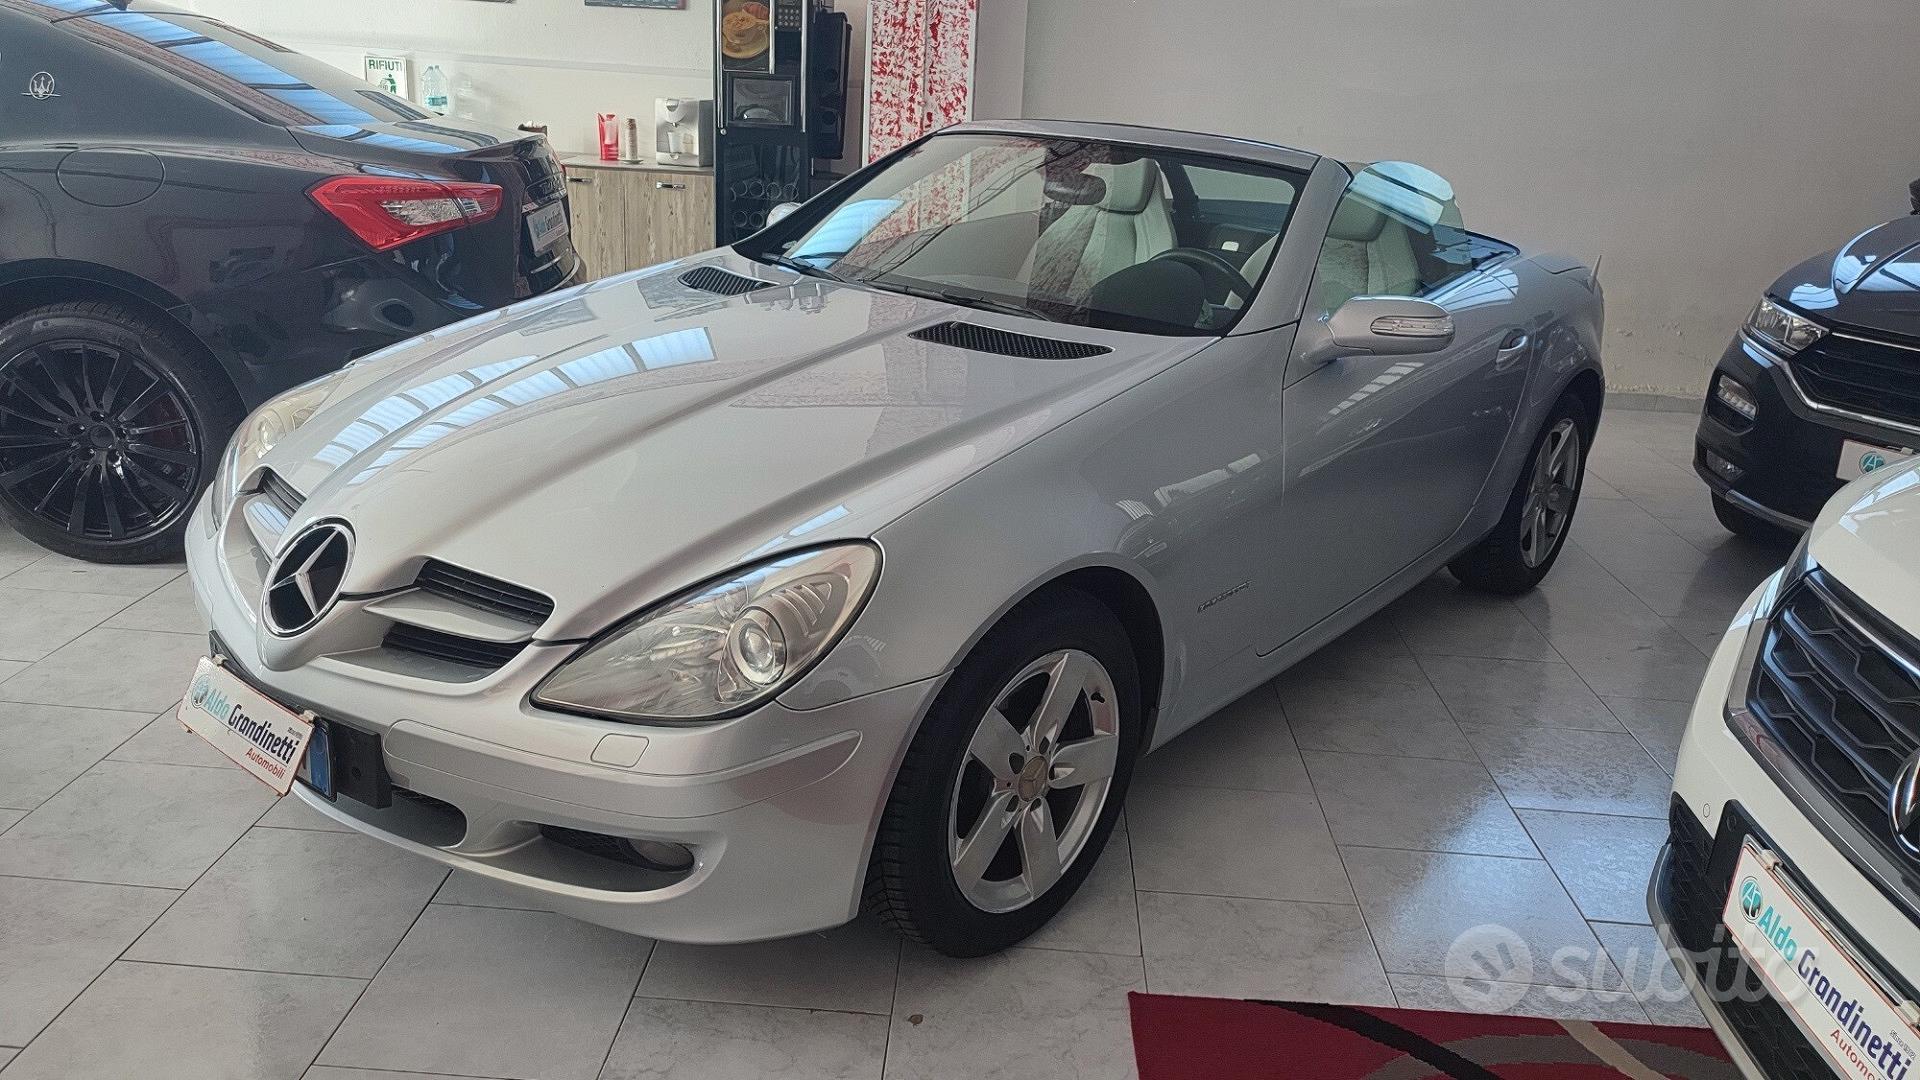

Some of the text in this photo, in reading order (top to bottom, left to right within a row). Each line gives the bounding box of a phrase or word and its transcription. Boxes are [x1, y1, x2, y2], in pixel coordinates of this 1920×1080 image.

[368, 59, 403, 72] RIFIUTI
[204, 688, 300, 764] Aldo Grandinetti
[245, 747, 286, 780] Automobili
[1758, 905, 1912, 1080] Aldo Grandinetti
[1830, 1028, 1881, 1080] Automo
